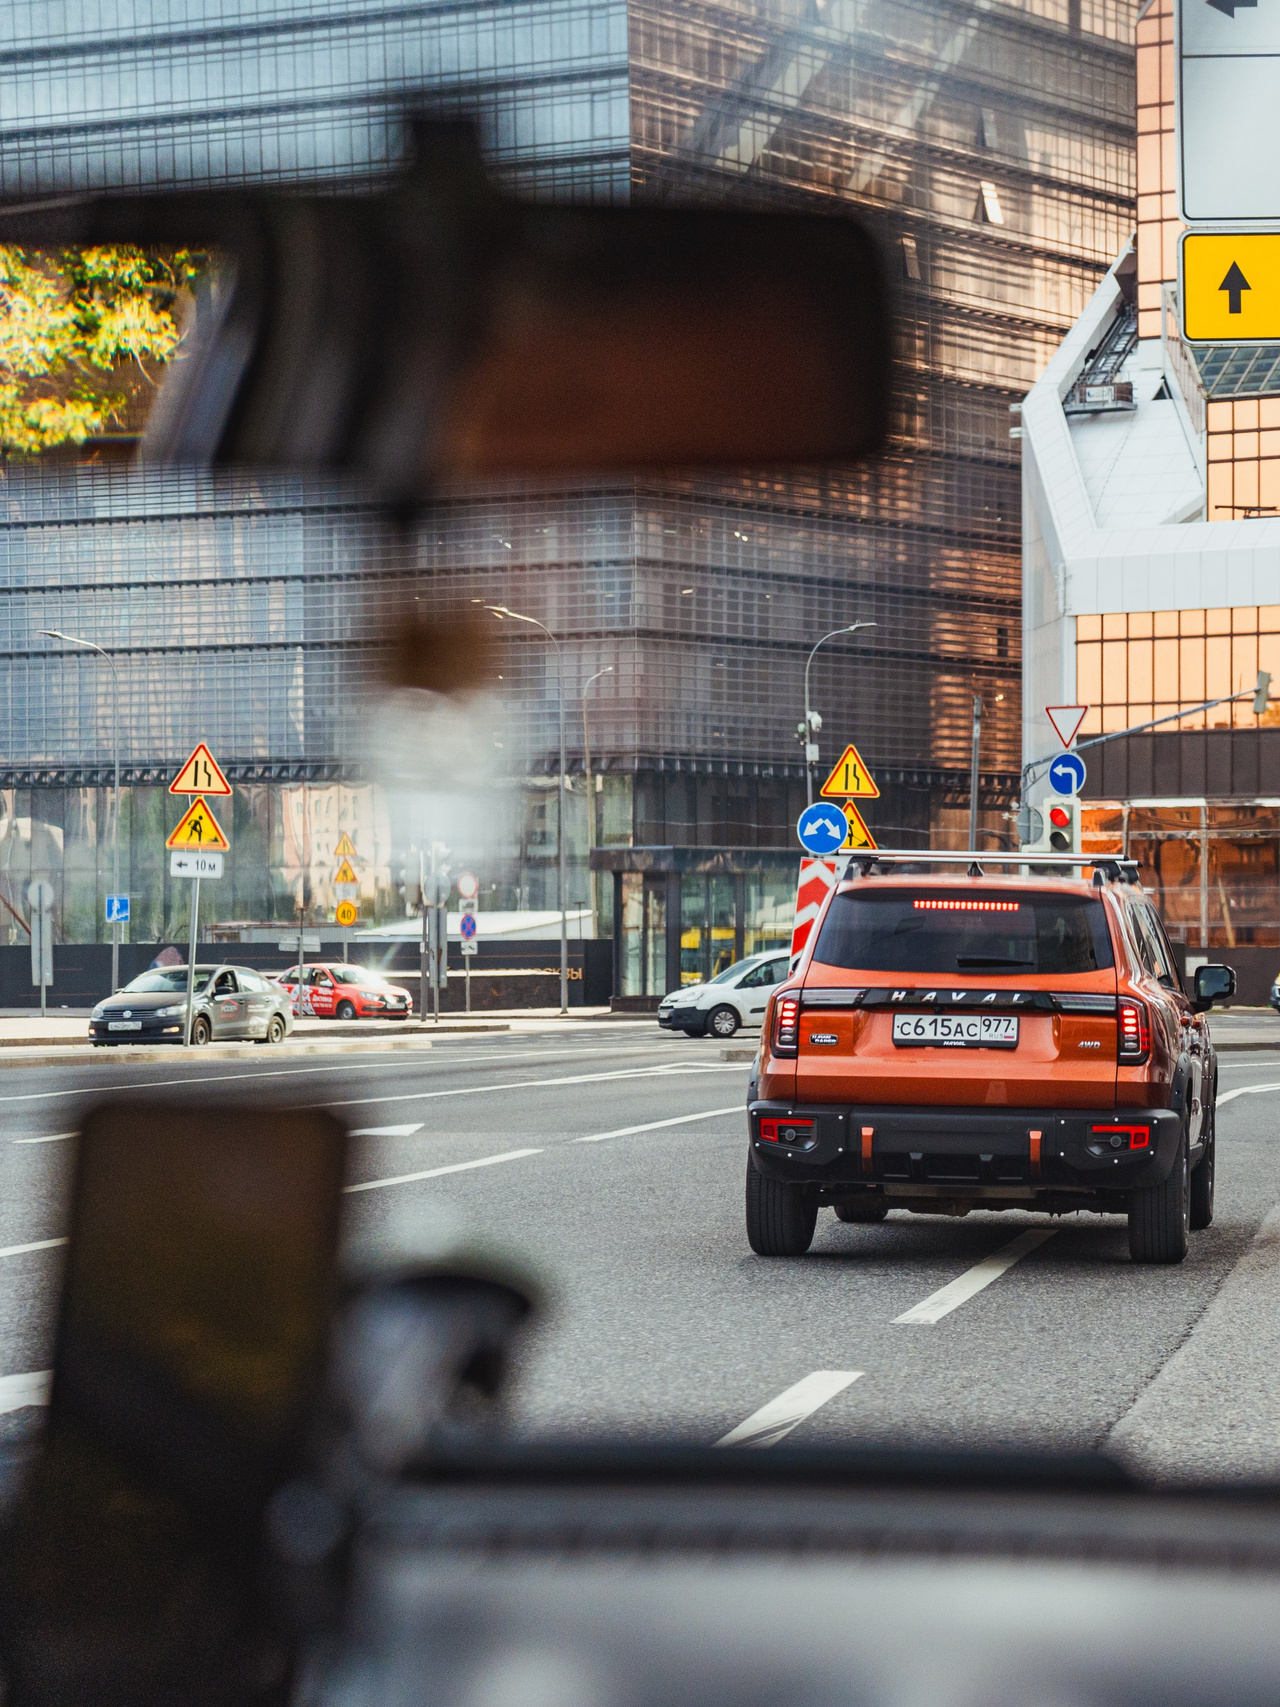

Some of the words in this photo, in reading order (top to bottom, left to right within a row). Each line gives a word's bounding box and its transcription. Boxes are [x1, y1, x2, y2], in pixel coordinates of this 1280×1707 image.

[196, 859, 206, 871] 10
[340, 909, 352, 920] 40
[891, 991, 1025, 1005] HAVAL
[900, 1018, 978, 1037] С615АС
[982, 1018, 1012, 1033] 977
[1078, 1041, 1101, 1049] 4WD
